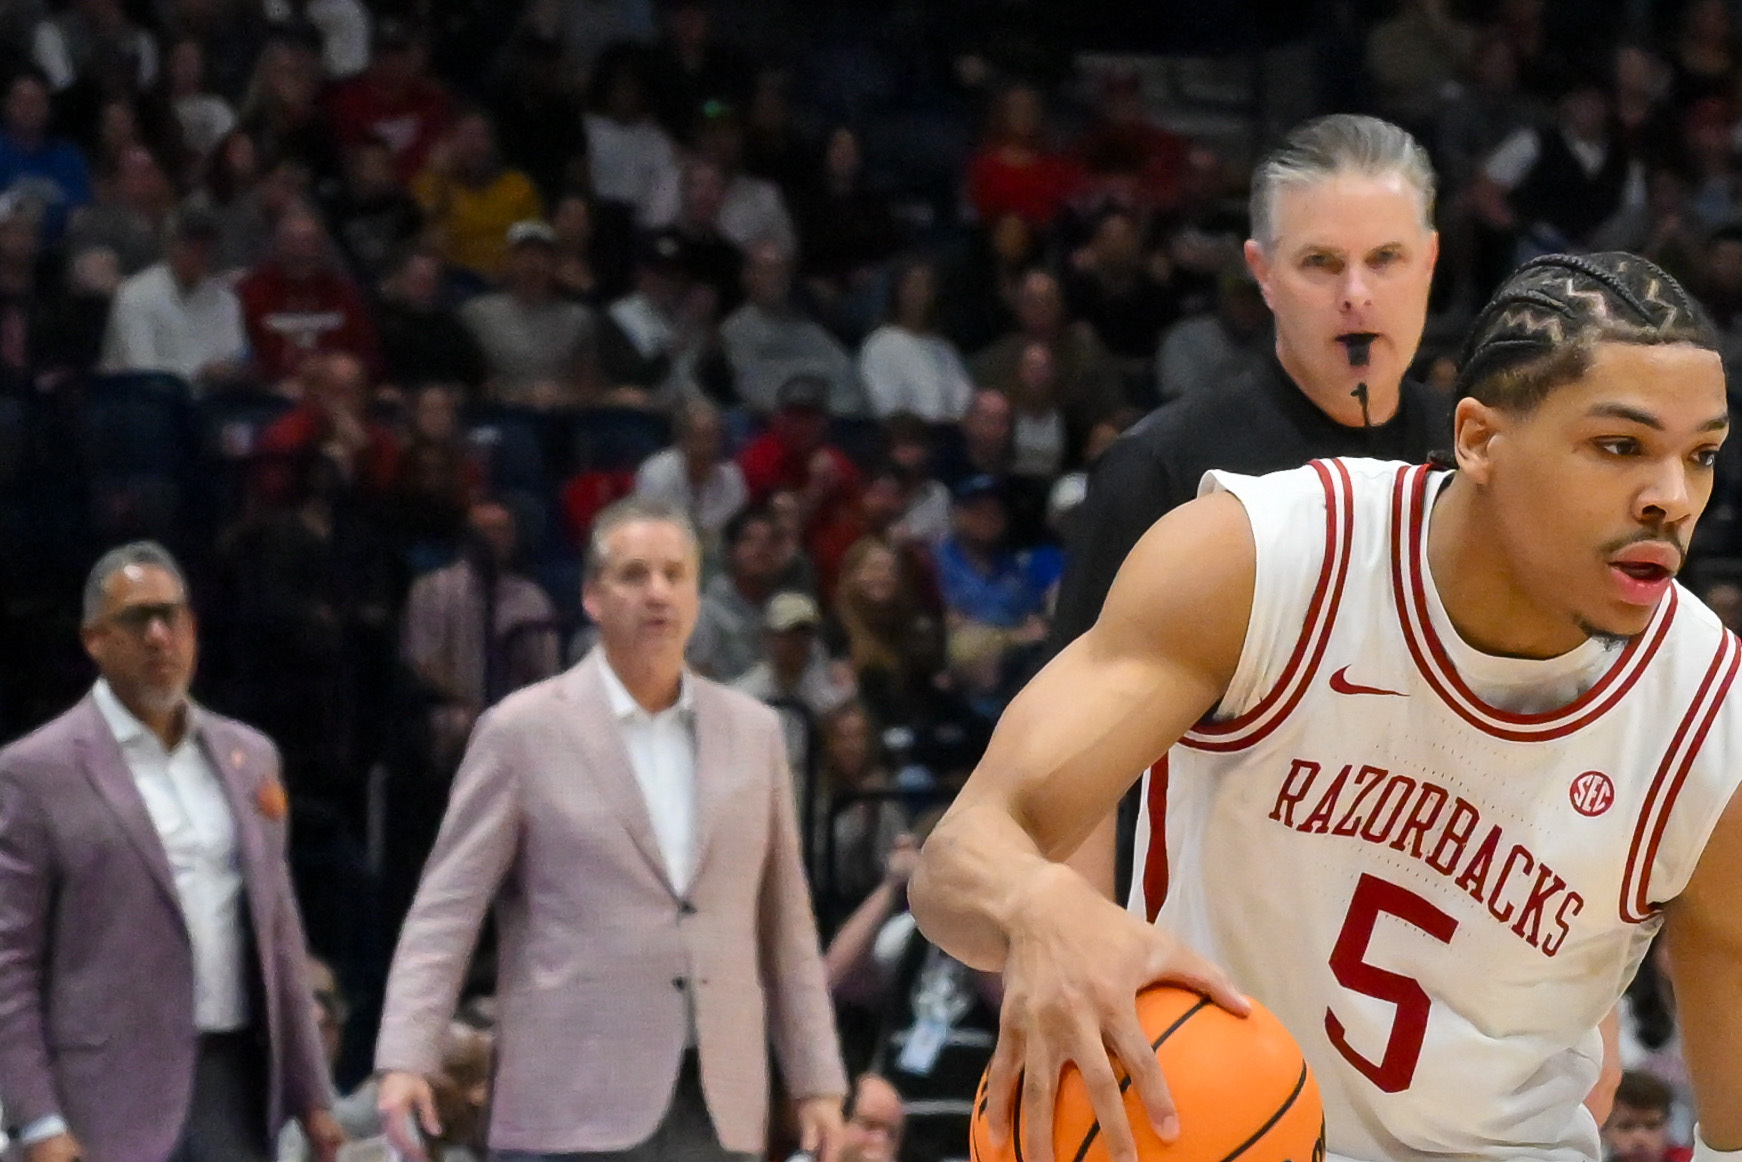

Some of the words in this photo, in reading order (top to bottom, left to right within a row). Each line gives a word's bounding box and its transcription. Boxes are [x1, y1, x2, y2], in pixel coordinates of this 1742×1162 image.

[1268, 758, 1585, 958] RAZORBACKS
[1573, 774, 1611, 813] SEC
[1324, 872, 1460, 1095] 5
